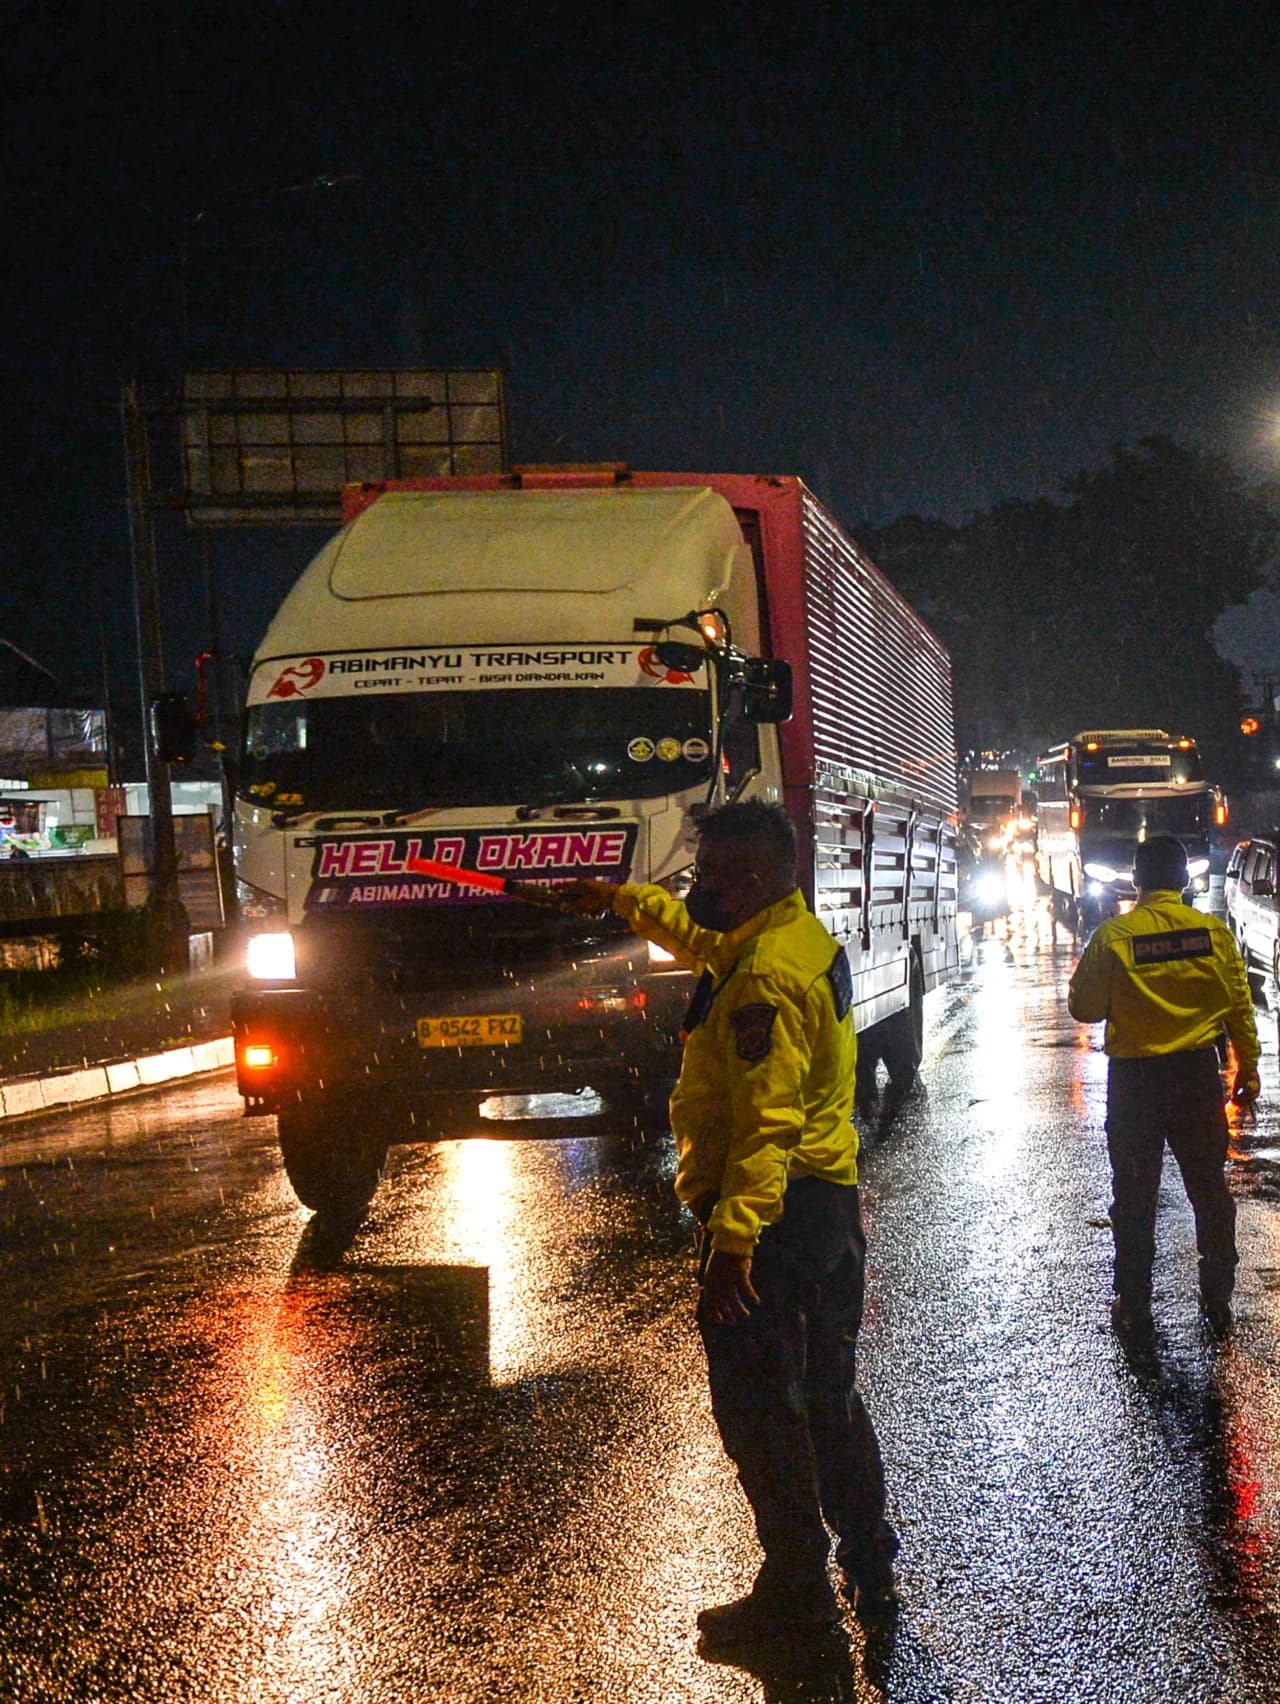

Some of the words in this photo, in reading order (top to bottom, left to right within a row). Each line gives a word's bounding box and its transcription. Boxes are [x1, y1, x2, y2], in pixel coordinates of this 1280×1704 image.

[328, 654, 462, 674] ABIMANYU
[470, 651, 632, 667] TRANSPORT
[354, 678, 403, 689] CEPAT
[418, 675, 466, 686] TEPAT
[479, 673, 512, 683] BISA
[515, 671, 605, 682] DIANDALKAN
[318, 837, 465, 878] HELLO
[476, 831, 627, 870] OKANE
[348, 882, 452, 903] ABIMANYU
[420, 1021, 431, 1039] B
